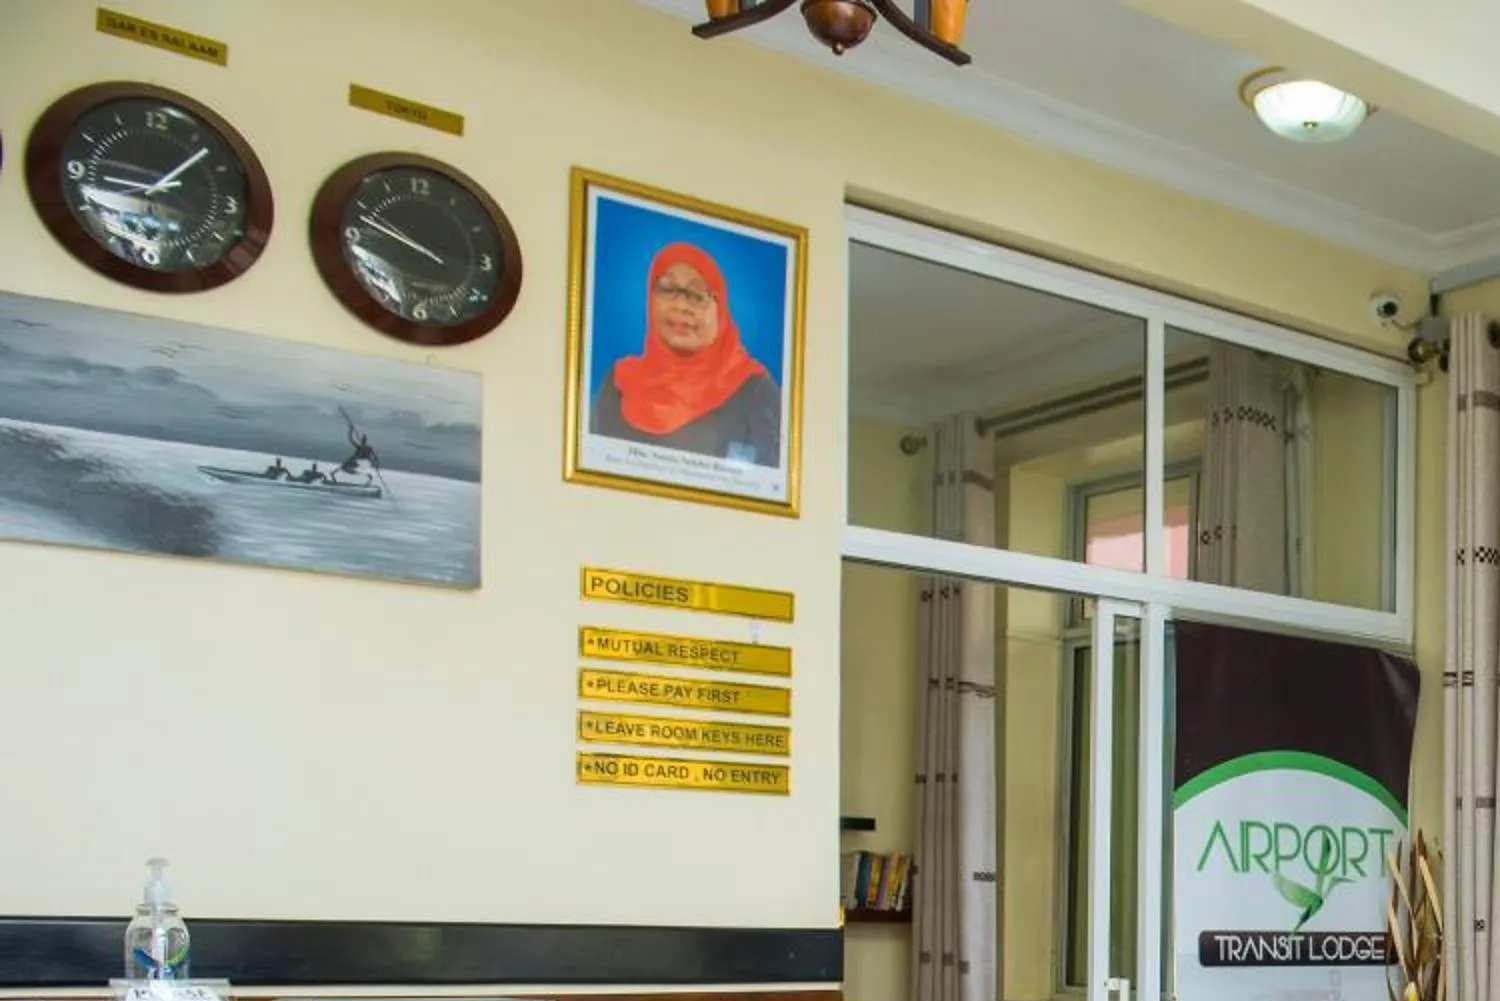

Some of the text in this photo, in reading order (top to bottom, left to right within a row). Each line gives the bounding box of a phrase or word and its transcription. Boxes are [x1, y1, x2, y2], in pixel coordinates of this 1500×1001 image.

[591, 576, 689, 602] POLICIES
[596, 637, 739, 664] MUTUAL RESPECT
[596, 679, 740, 703] PLEASE PAY FIRST
[595, 721, 785, 748] LEAVE ROOM KEYS HERE
[594, 761, 618, 775] NO
[623, 763, 639, 776] ID
[703, 768, 726, 782] NO
[731, 770, 780, 785] ENTRY
[1197, 819, 1395, 878] AIRPORT
[1214, 935, 1385, 961] TRANSIT LODGE
